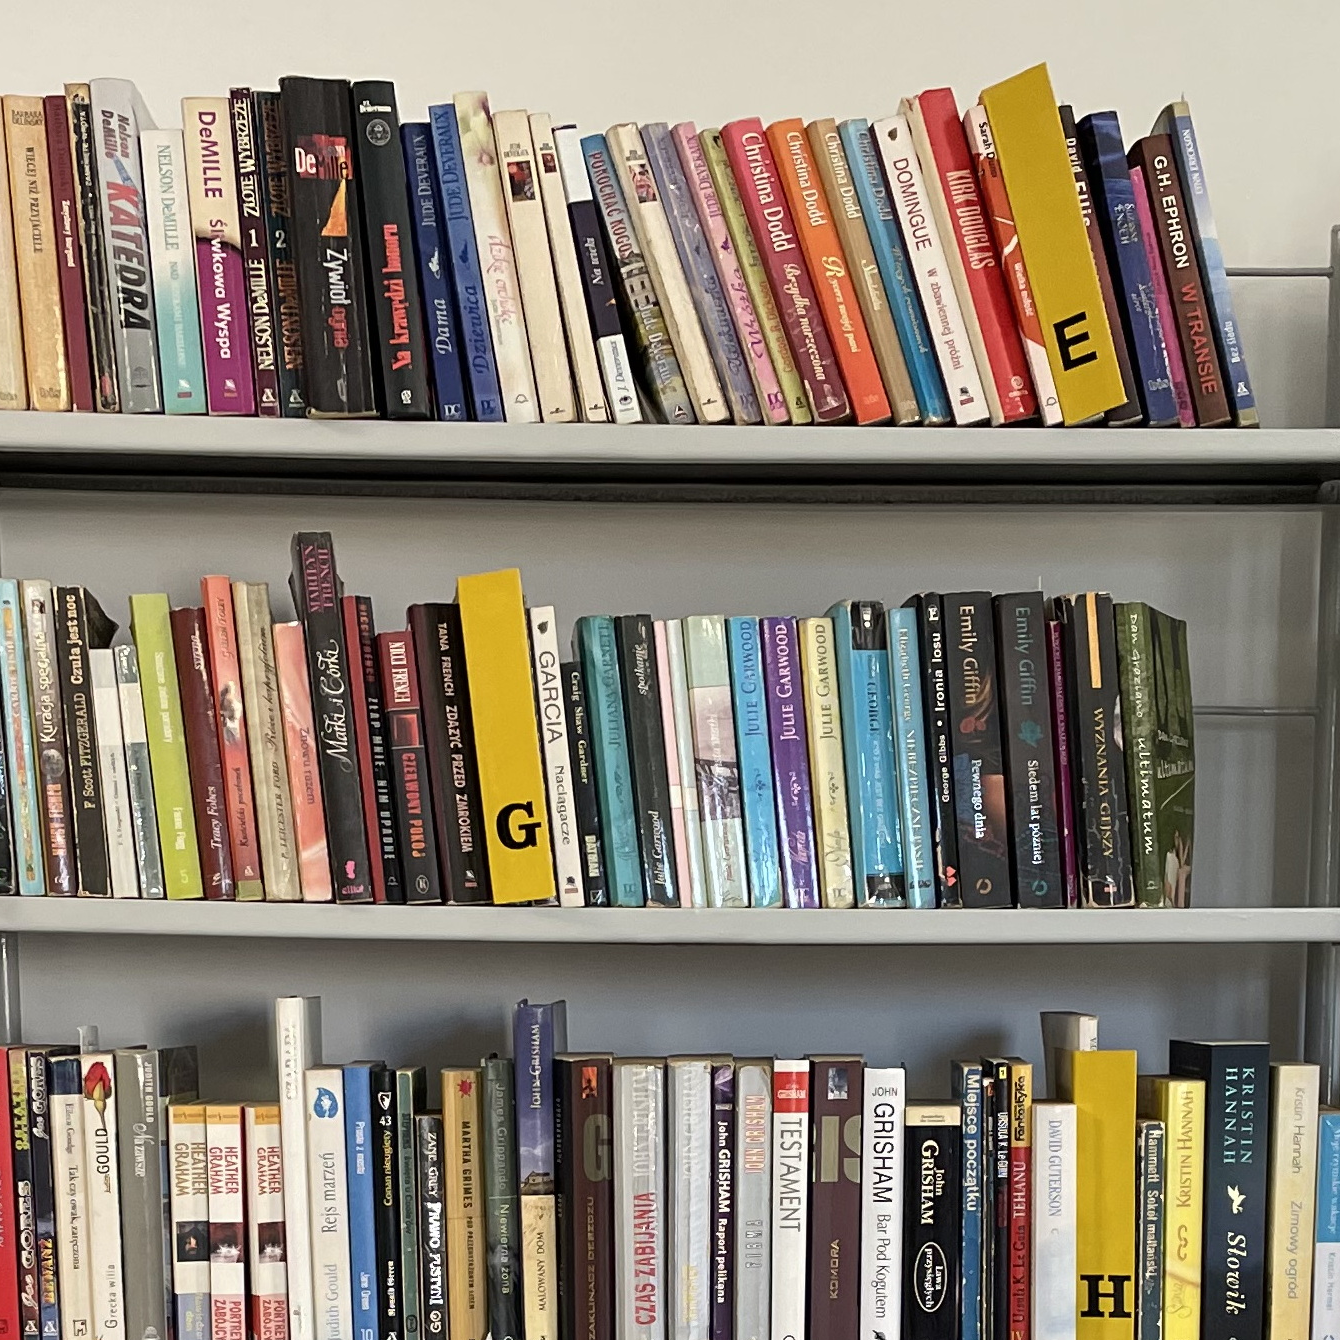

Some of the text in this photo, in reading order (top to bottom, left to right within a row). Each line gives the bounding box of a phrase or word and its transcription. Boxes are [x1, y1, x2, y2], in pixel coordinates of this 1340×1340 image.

[197, 111, 223, 200] DeMILLE
[741, 132, 793, 252] Christina Dodd
[893, 158, 931, 251] DOMINGUE
[944, 169, 995, 270] KIRK DOUGLAS
[107, 181, 151, 330] KATEDRA
[1153, 155, 1217, 395] G.H. EPHRON W TRANSIE
[1053, 312, 1097, 371] E
[540, 651, 563, 745] GARCIA
[931, 633, 943, 711] Ironia losu
[438, 622, 473, 852] TANA FRENCH PRZED ZMROKIEM
[497, 802, 541, 849] G
[872, 1087, 898, 1097] JOHN
[1225, 1068, 1237, 1165] HANNAH
[1241, 1066, 1255, 1165] KRISTIN
[97, 1126, 109, 1175] GOULD
[175, 1142, 189, 1196] GRAHAM
[191, 1142, 205, 1196] HEATHER
[321, 1152, 335, 1234] Rejs marzeń
[779, 1118, 802, 1232] TESTAMENT
[873, 1103, 895, 1318] GRISHAM Bar Pod Kogutem
[1081, 1274, 1133, 1318] H
[1225, 1232, 1247, 1316] Słowik
